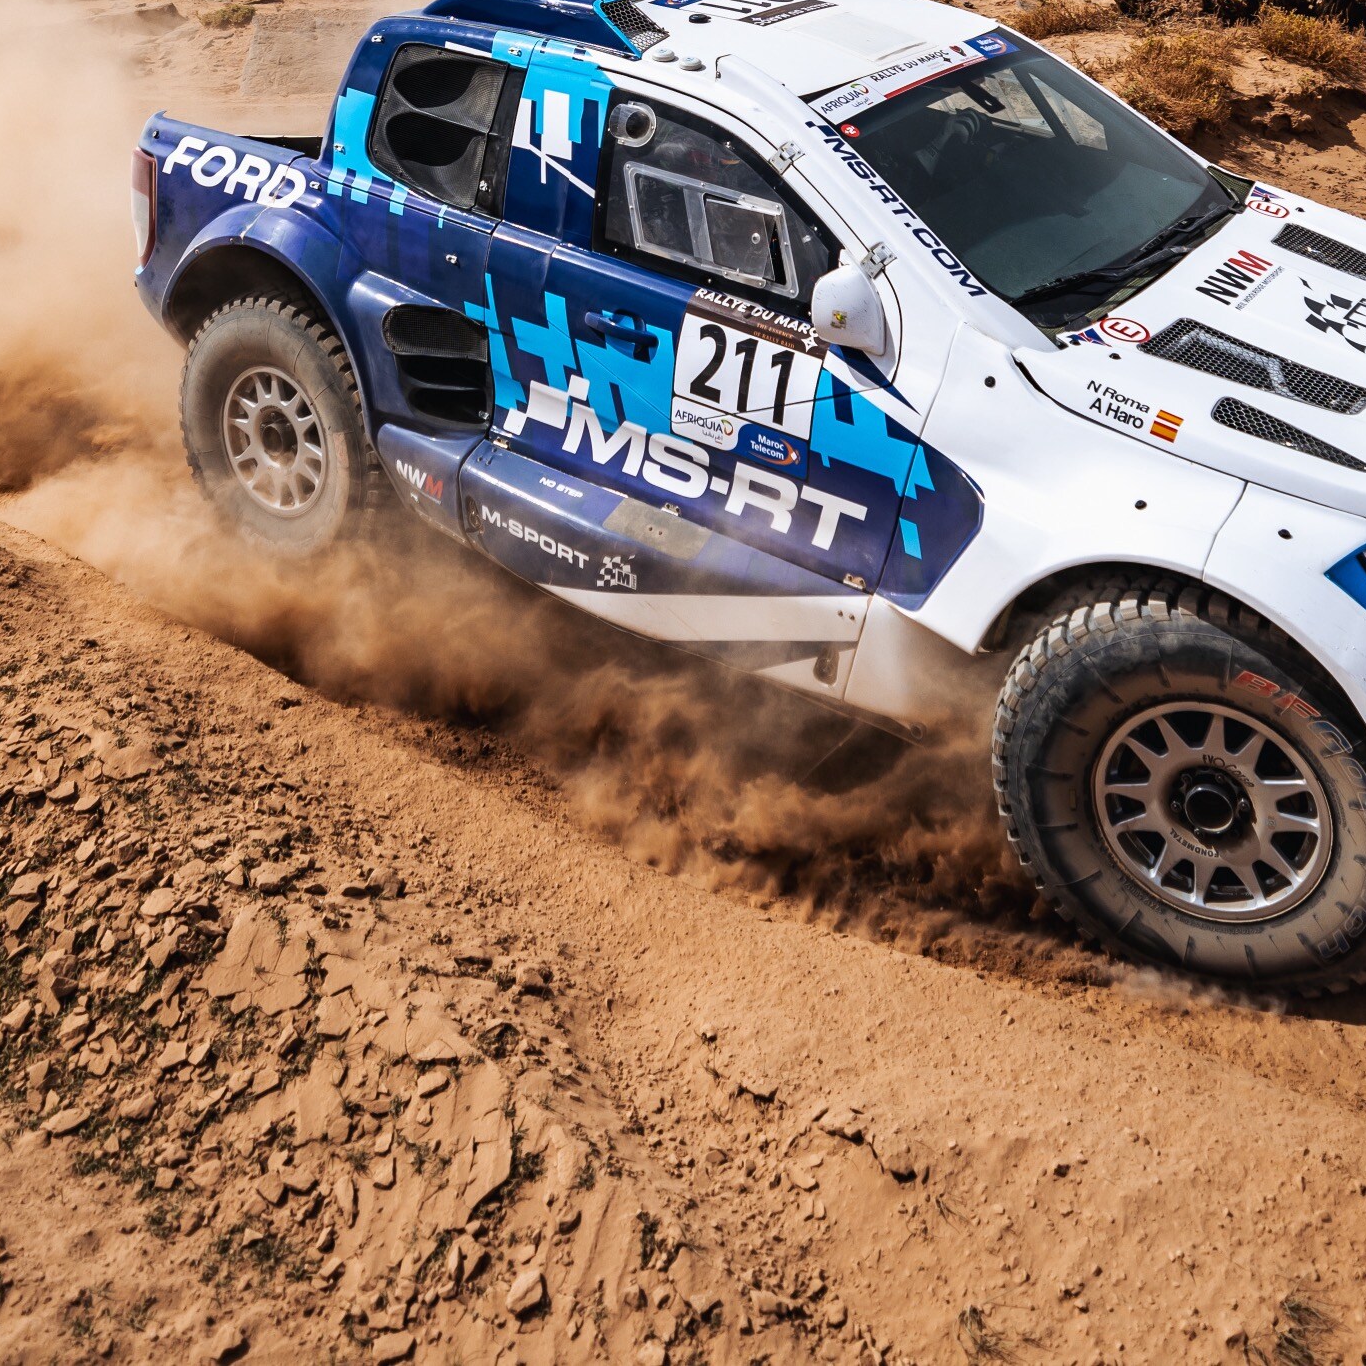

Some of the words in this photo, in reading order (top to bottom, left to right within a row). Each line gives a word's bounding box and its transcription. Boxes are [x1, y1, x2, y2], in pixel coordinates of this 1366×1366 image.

[870, 64, 906, 83] RALLYE
[904, 59, 919, 70] DU
[918, 48, 950, 65] MAROC
[821, 89, 862, 114] AFRIQUIA
[162, 136, 307, 209] FORD
[823, 138, 988, 297] MS-RT.COM
[1195, 250, 1273, 305] NWM
[695, 287, 750, 313] RALLYE
[751, 307, 774, 321] DU
[757, 322, 767, 330] THE
[768, 326, 794, 339] ESSENCE
[761, 333, 779, 344] RALLY
[780, 339, 795, 349] RAID
[690, 324, 795, 426] 211
[1086, 380, 1102, 393] N
[1103, 386, 1150, 414] Roma
[1089, 397, 1102, 414] A
[1105, 402, 1144, 429] Haro
[675, 409, 723, 434] AFRIQUIA
[750, 441, 784, 461] Telecom
[757, 434, 784, 451] Maroc
[395, 459, 444, 500] NWM
[538, 476, 557, 489] NO
[557, 484, 584, 499] STEP
[562, 401, 868, 552] MS-RT
[481, 505, 590, 569] M-SPORT
[1170, 828, 1219, 857] FONDMETAL
